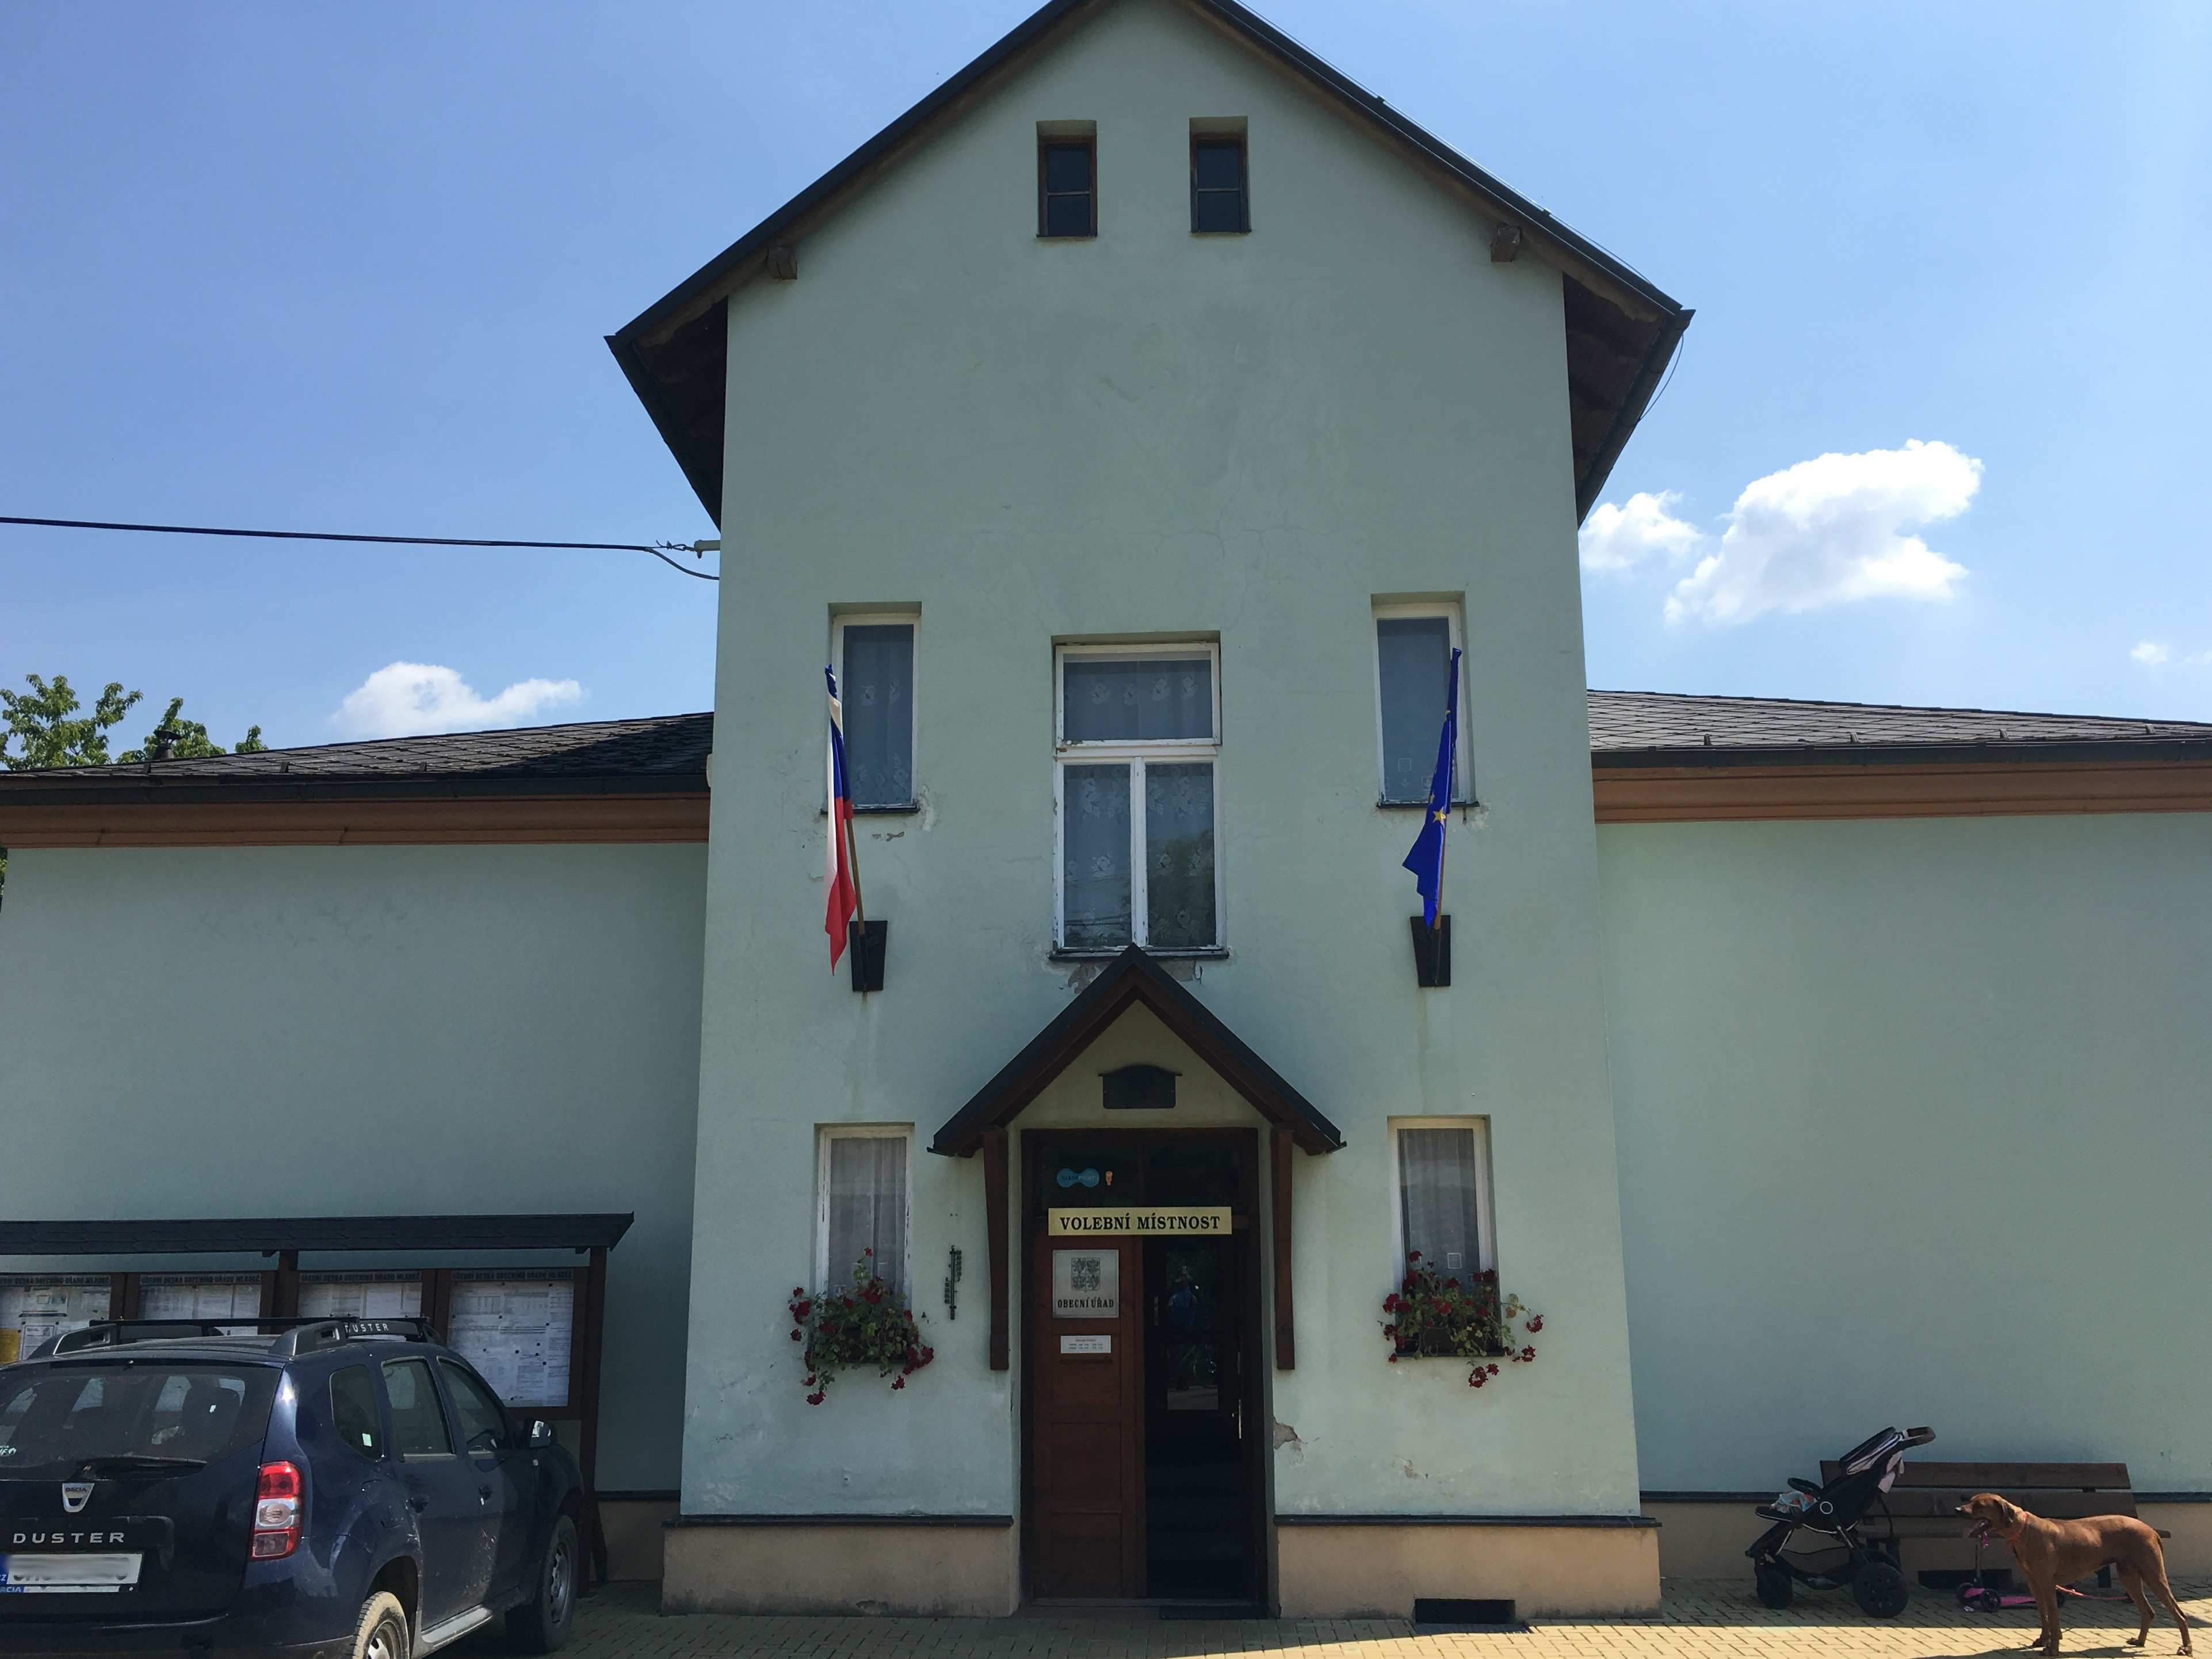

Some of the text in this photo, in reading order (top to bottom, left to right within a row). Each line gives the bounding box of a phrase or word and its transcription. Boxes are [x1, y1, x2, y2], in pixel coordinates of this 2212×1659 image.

[1060, 1212, 1220, 1230] VOLEBNÍ MÍSTNOST
[1057, 1297, 1114, 1308] OBECNÍ ÚŘAD
[13, 1532, 124, 1543] DUSTER
